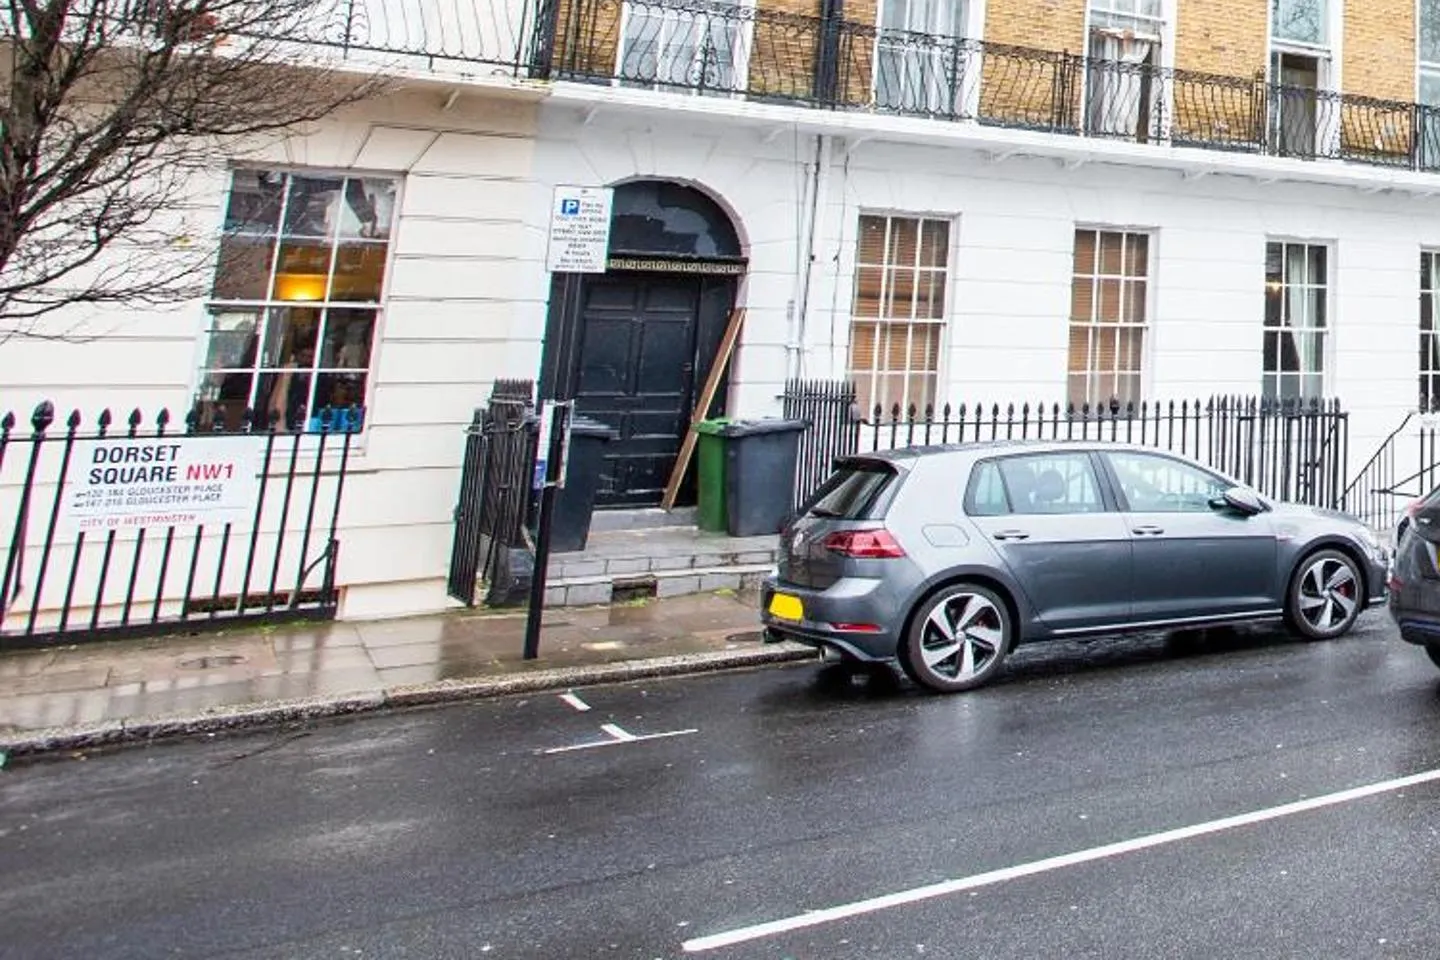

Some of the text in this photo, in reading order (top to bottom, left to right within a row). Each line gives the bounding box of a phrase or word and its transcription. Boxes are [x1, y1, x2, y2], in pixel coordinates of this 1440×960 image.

[92, 444, 181, 464] DORSET
[88, 464, 234, 485] SQUARE NW1
[194, 483, 223, 492] PLACE
[126, 494, 189, 506] GLOUCESTER
[192, 492, 221, 502] PLACE
[80, 513, 196, 527] CITY OF WESTMINSTER
